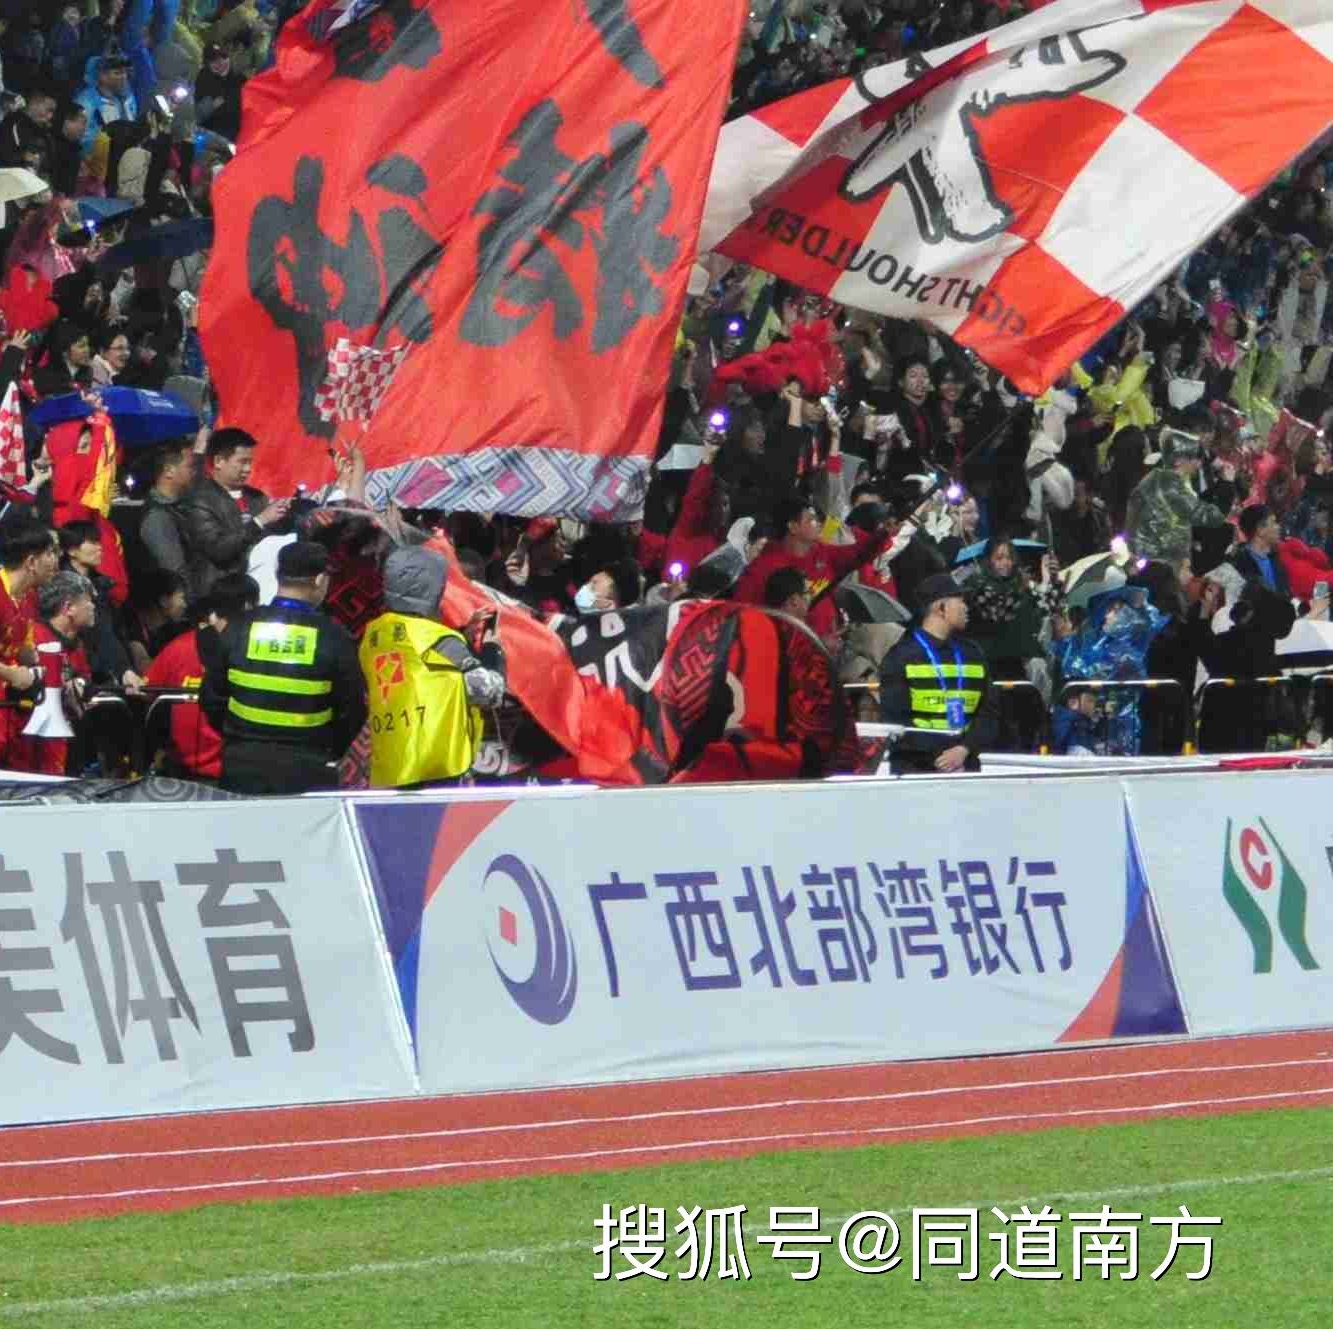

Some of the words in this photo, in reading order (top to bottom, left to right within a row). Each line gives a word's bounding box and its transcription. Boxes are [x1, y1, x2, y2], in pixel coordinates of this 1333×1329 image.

[372, 705, 426, 734] 0217
[587, 856, 1073, 998] 广西北部湾银行
